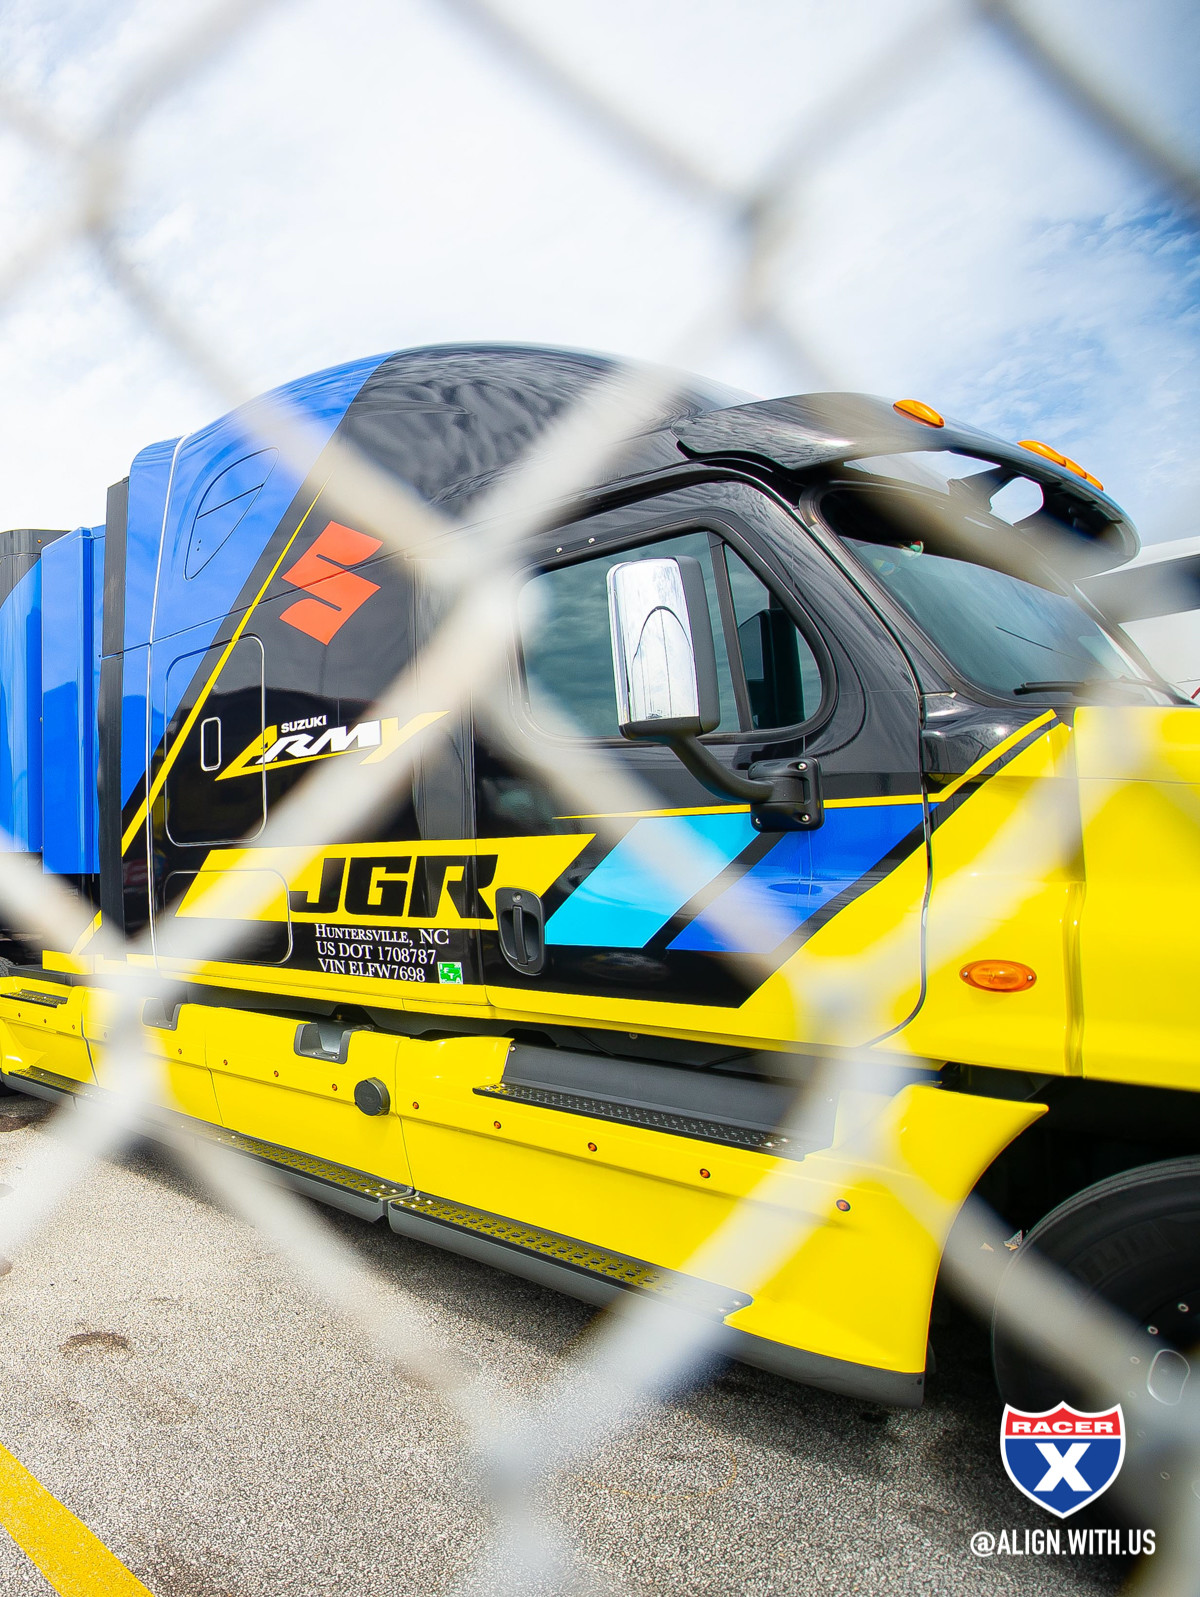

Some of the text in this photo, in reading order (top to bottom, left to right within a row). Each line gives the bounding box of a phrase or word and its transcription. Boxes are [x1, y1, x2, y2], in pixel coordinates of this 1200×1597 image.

[281, 715, 327, 734] SUZUKI
[214, 711, 450, 781] ARMY
[289, 854, 499, 919] JGR
[315, 923, 450, 947] HUNTERSVILLE, NC
[317, 940, 437, 965] US DOT 1708787
[318, 957, 426, 982] VIN ELFW7698
